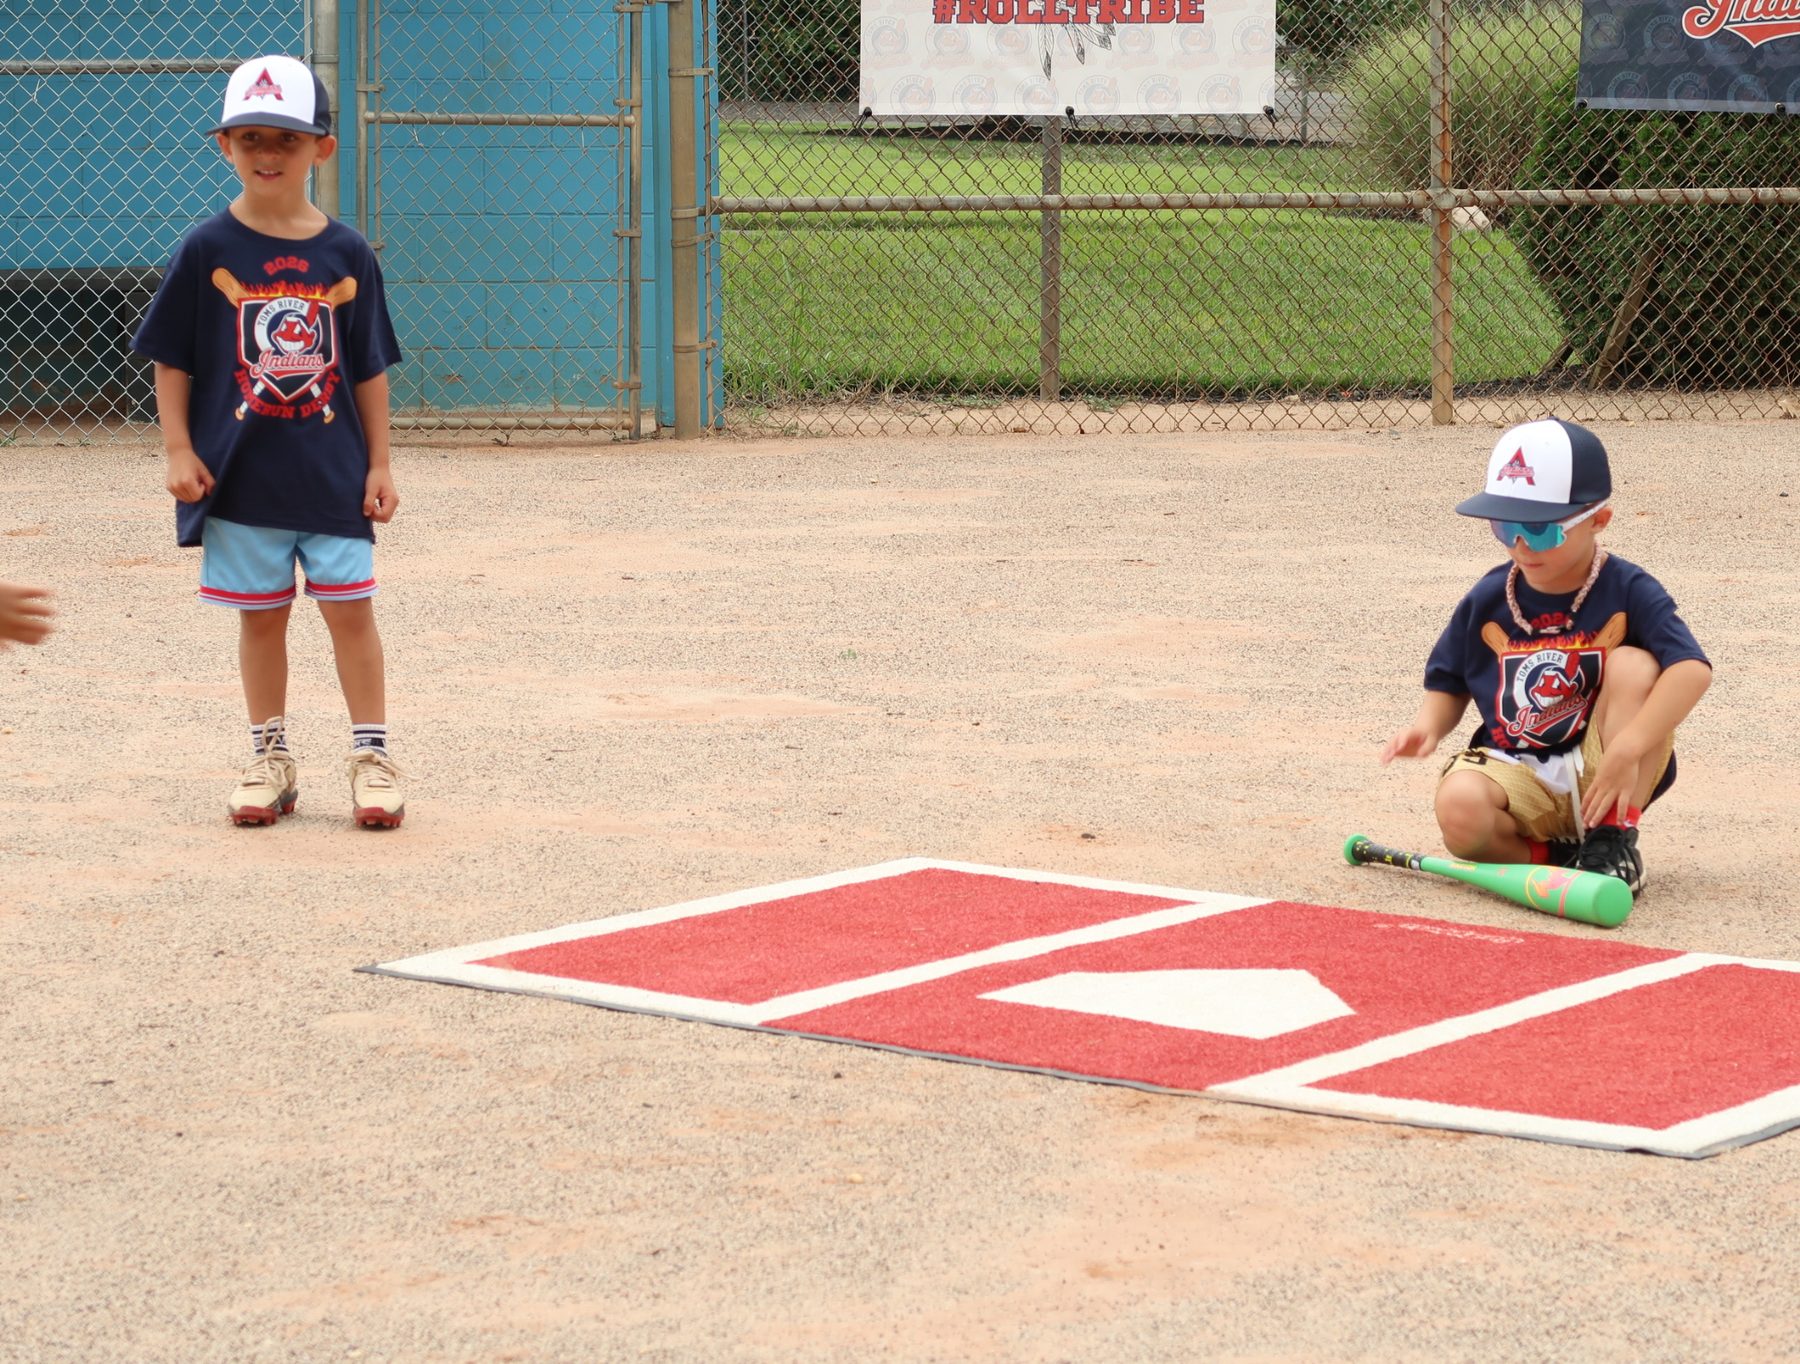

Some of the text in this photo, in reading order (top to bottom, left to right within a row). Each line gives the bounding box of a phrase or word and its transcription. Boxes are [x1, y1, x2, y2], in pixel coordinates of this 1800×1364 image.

[932, 0, 1205, 24] #ROLLTRIBE
[242, 68, 284, 100] A
[257, 298, 305, 327] TOMS RIVER
[250, 348, 325, 379] Indians
[1496, 446, 1536, 486] A
[1516, 651, 1563, 683] TOMS RIVER
[1506, 694, 1584, 736] Indians
